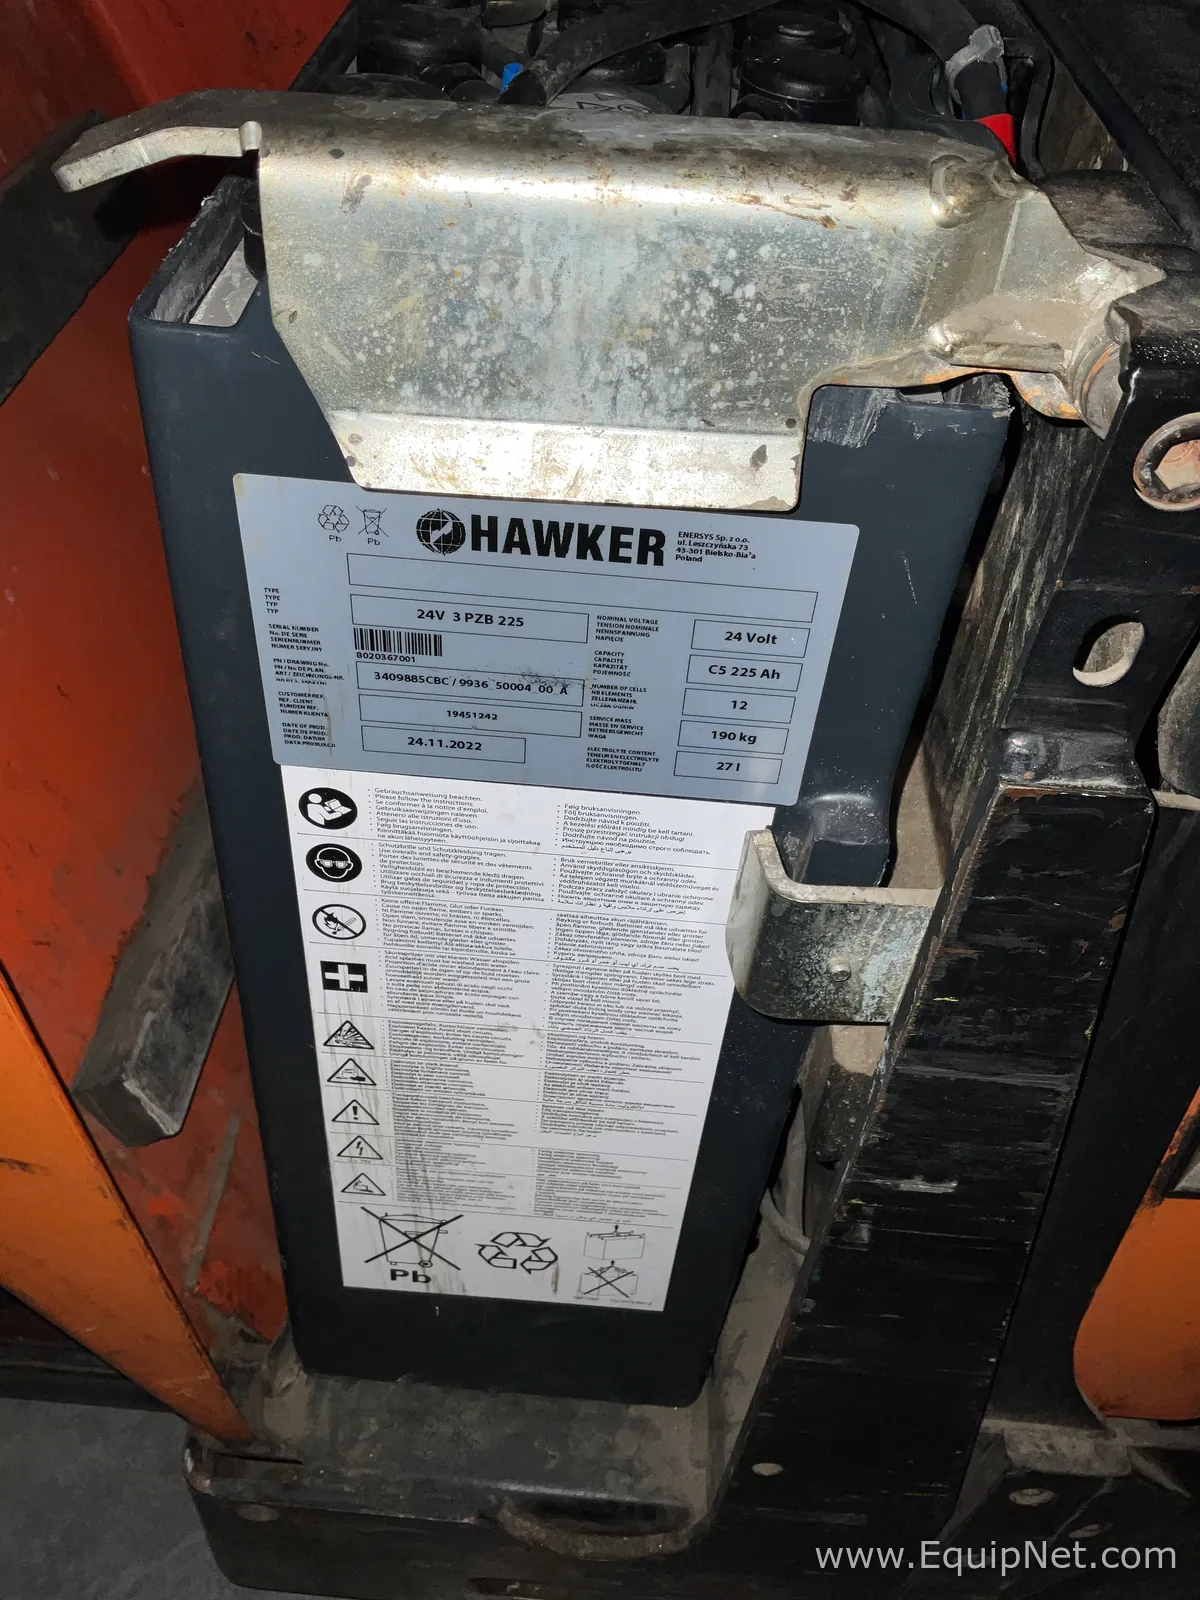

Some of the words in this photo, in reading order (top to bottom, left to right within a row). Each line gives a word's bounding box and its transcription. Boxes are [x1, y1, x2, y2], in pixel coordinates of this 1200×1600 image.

[328, 534, 341, 542] Pb
[366, 537, 380, 545] Pb
[471, 514, 665, 566] HAWKER
[678, 531, 713, 540] ENERSYS
[715, 534, 727, 542] Sp.
[689, 540, 736, 550] Leszczyńska
[738, 543, 748, 551] 73
[675, 547, 703, 555] 43-301
[675, 554, 702, 562] Poland
[417, 609, 445, 620] 24V
[453, 612, 461, 622] 3
[465, 613, 493, 624] PZB
[498, 616, 524, 627] 225
[596, 614, 627, 622] NOMINAL
[628, 617, 658, 625] VOLTAGE
[596, 621, 624, 629] TENSION
[595, 629, 650, 637] NENNSPANNUNG
[725, 631, 742, 641] 24
[747, 633, 777, 644] Volt
[270, 637, 320, 645] SERIENNUMMER
[595, 634, 623, 642] NAPIĘCIE
[295, 644, 322, 652] SERYJNY
[286, 658, 317, 666] DRAWING
[356, 652, 415, 663] 8020367001
[593, 656, 623, 664] CAPACITE
[709, 665, 726, 675] C5
[731, 667, 757, 677] 225
[760, 669, 780, 679] Ah
[375, 672, 449, 685] 3409885CBC
[590, 696, 637, 704] ZELLENANZAHL
[732, 701, 747, 710] 12
[447, 710, 497, 720] 19451242
[588, 728, 643, 736] BETRIEBSGEWICHT
[712, 731, 736, 740] 190
[739, 732, 756, 744] kg
[408, 737, 482, 751] 24.11.2022
[586, 746, 626, 754] ELECTROLYTE
[585, 758, 645, 766] ELEKTROLYTGEHALT
[619, 754, 659, 762] ELECTROLYTE
[603, 764, 642, 772] ELEKTROLITU
[716, 762, 733, 770] 27
[375, 788, 447, 799] Gebrauchsanweisung
[448, 793, 482, 801] beachten.
[375, 798, 383, 806] Se
[397, 794, 419, 802] follow
[432, 798, 474, 806] instructions.
[581, 805, 640, 815] bruksanvisningen.
[420, 813, 451, 821] istruzioni
[577, 810, 638, 820] bruksanvisningen.
[376, 815, 397, 823] Seguir
[408, 819, 453, 827] instrucciones
[393, 823, 453, 833] brugsanvisningen.
[377, 842, 416, 850] Schutzbrille
[433, 847, 482, 856] Schutzkleidung
[390, 1268, 431, 1284] Pb
